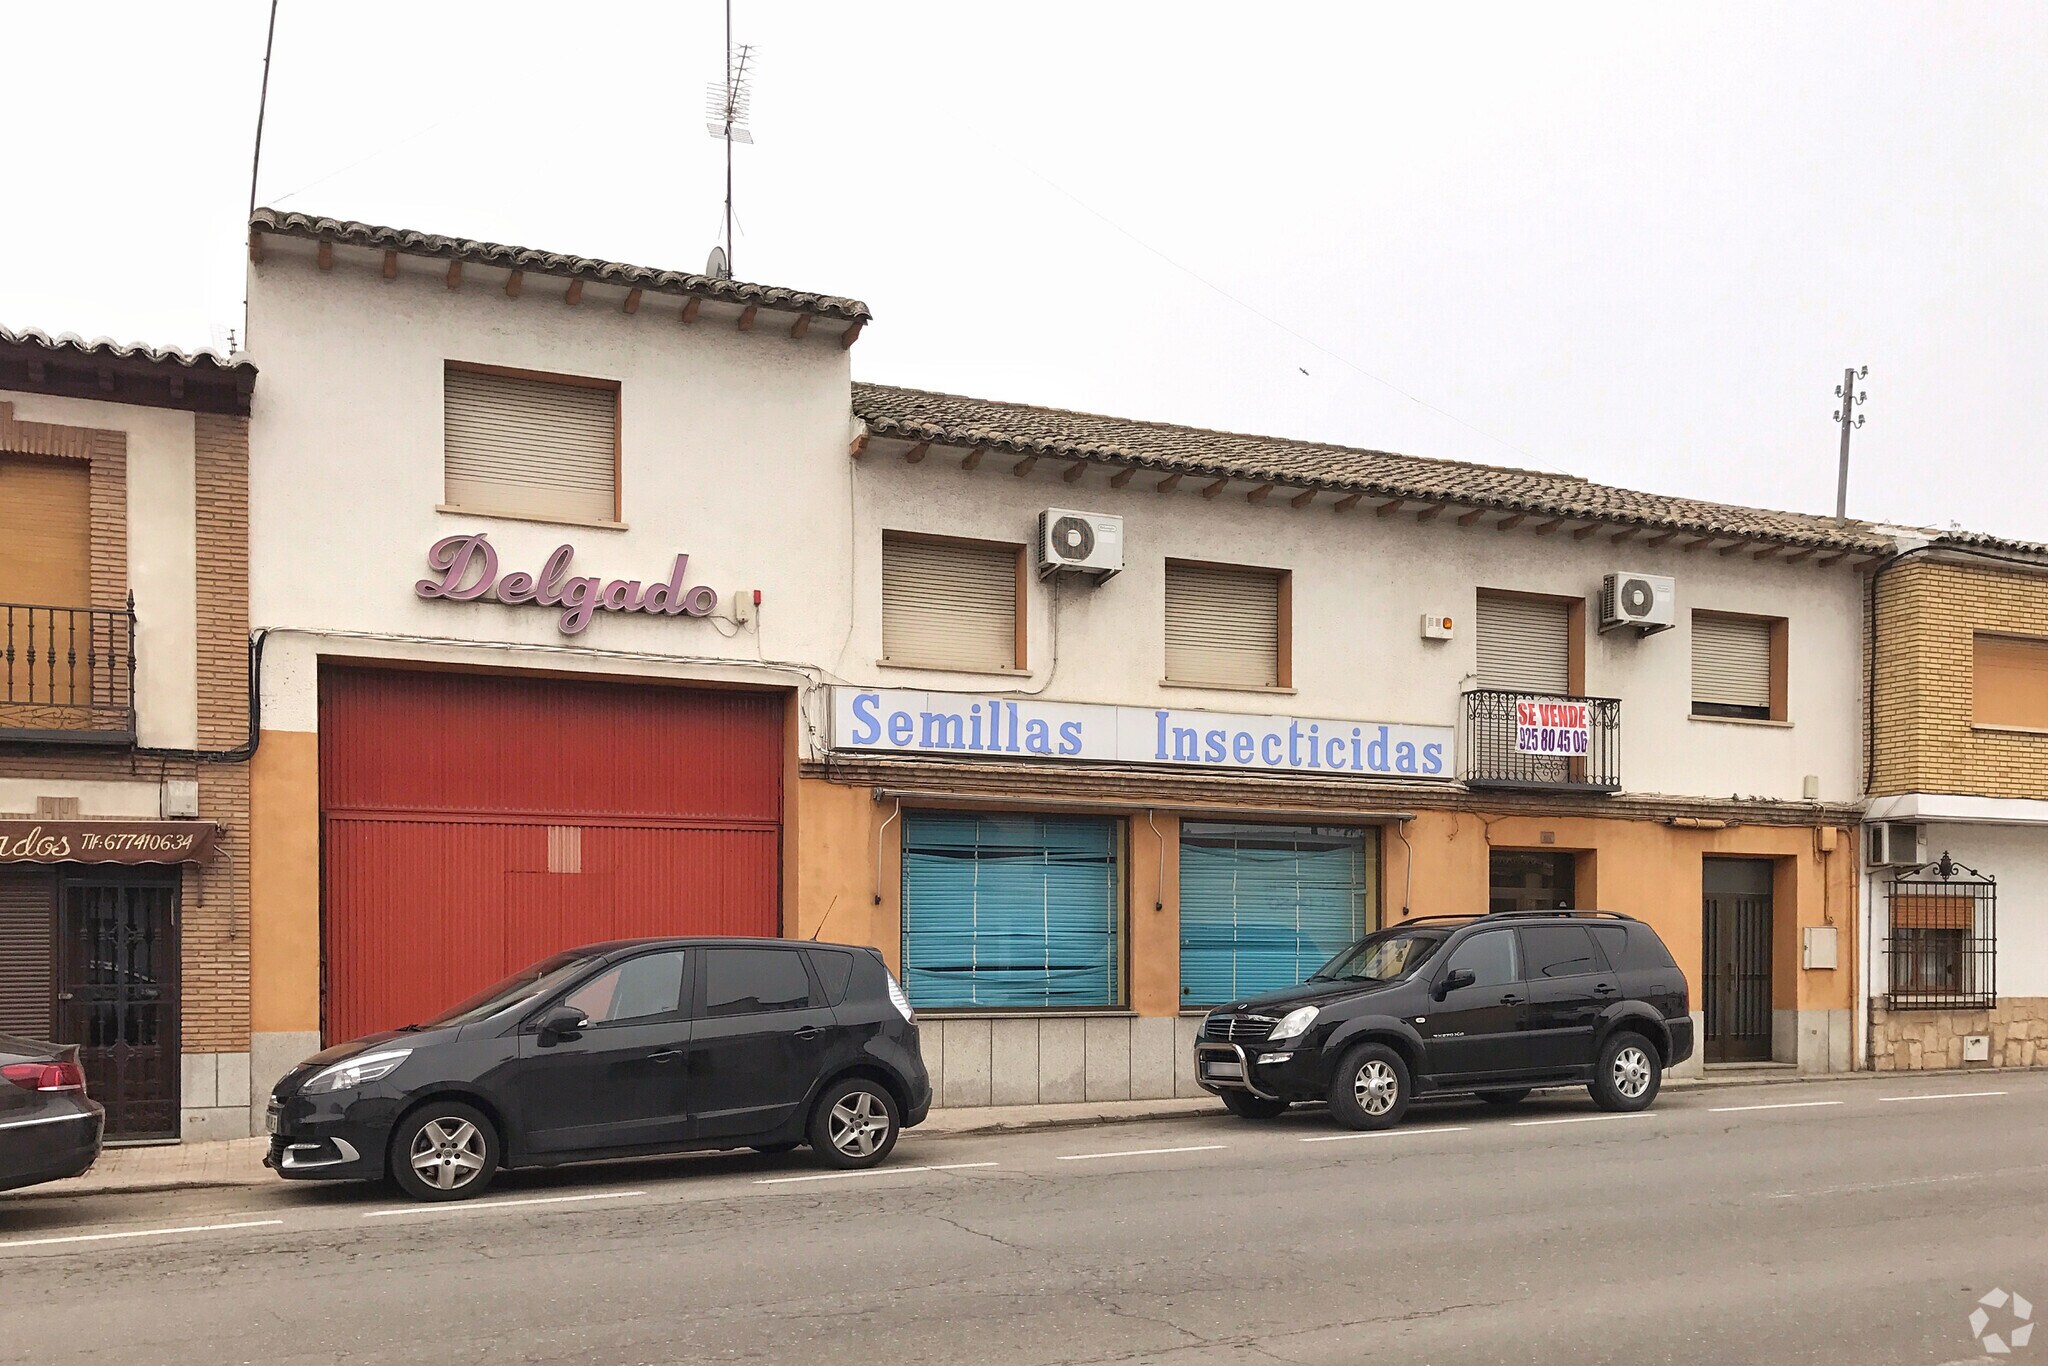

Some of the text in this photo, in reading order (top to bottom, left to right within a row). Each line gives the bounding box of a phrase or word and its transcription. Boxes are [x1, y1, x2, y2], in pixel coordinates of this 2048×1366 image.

[415, 533, 718, 634] Delgado
[851, 694, 1444, 774] Semillas Insecticidas
[1517, 703, 1587, 728] SE VENDE
[1519, 727, 1587, 753] 925 80 45 06
